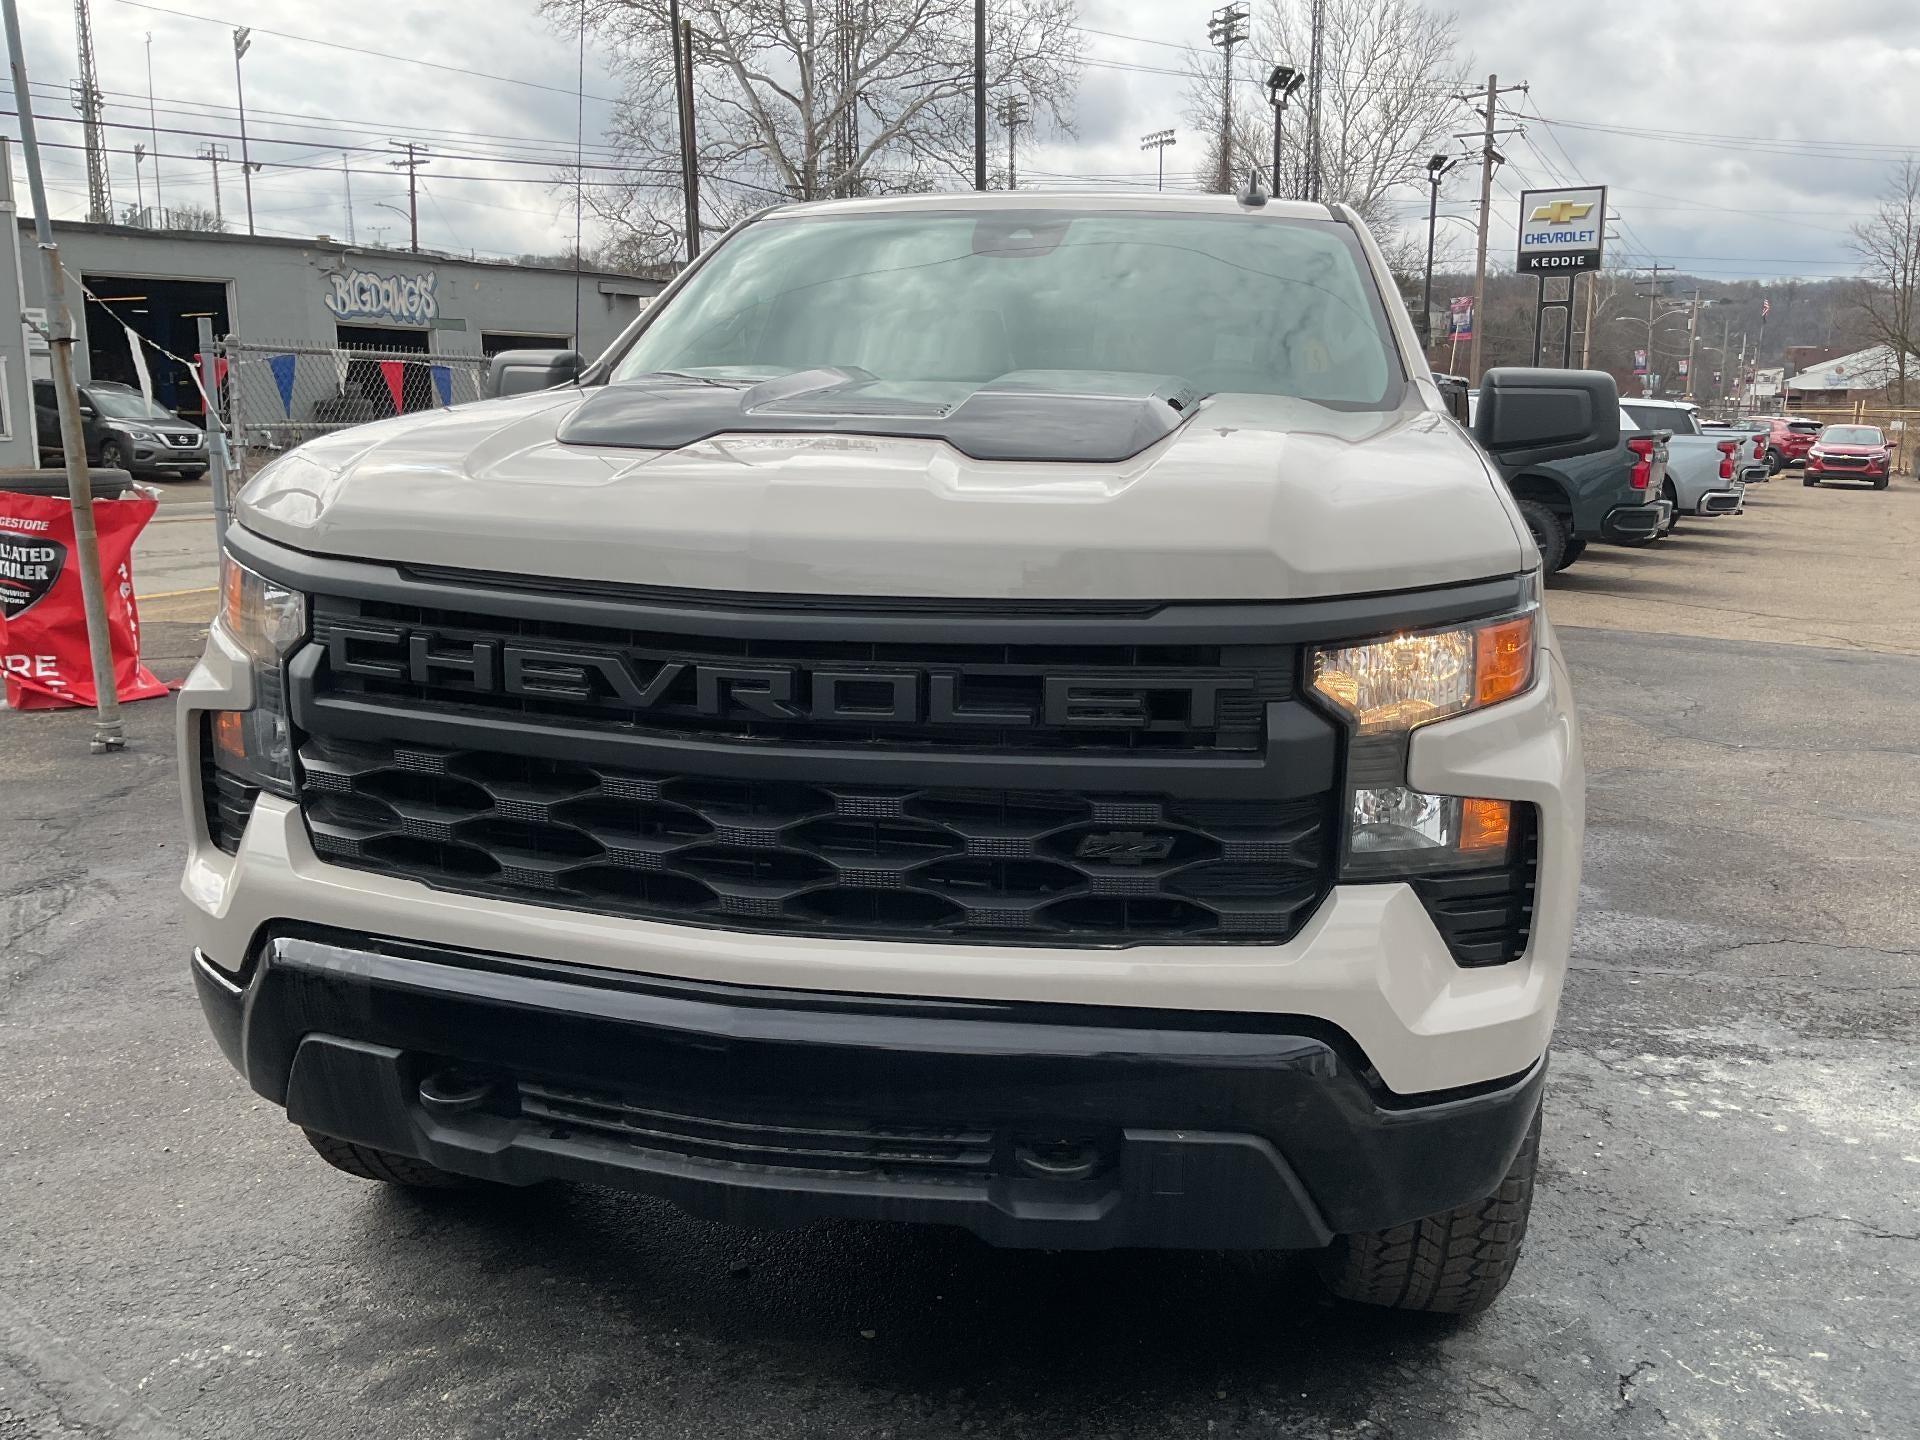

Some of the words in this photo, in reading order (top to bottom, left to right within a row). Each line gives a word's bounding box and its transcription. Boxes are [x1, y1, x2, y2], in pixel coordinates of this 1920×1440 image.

[1525, 230, 1595, 245] CHEVROLET
[1531, 255, 1585, 268] KEDDIE
[330, 626, 1256, 730] CHEVROLET
